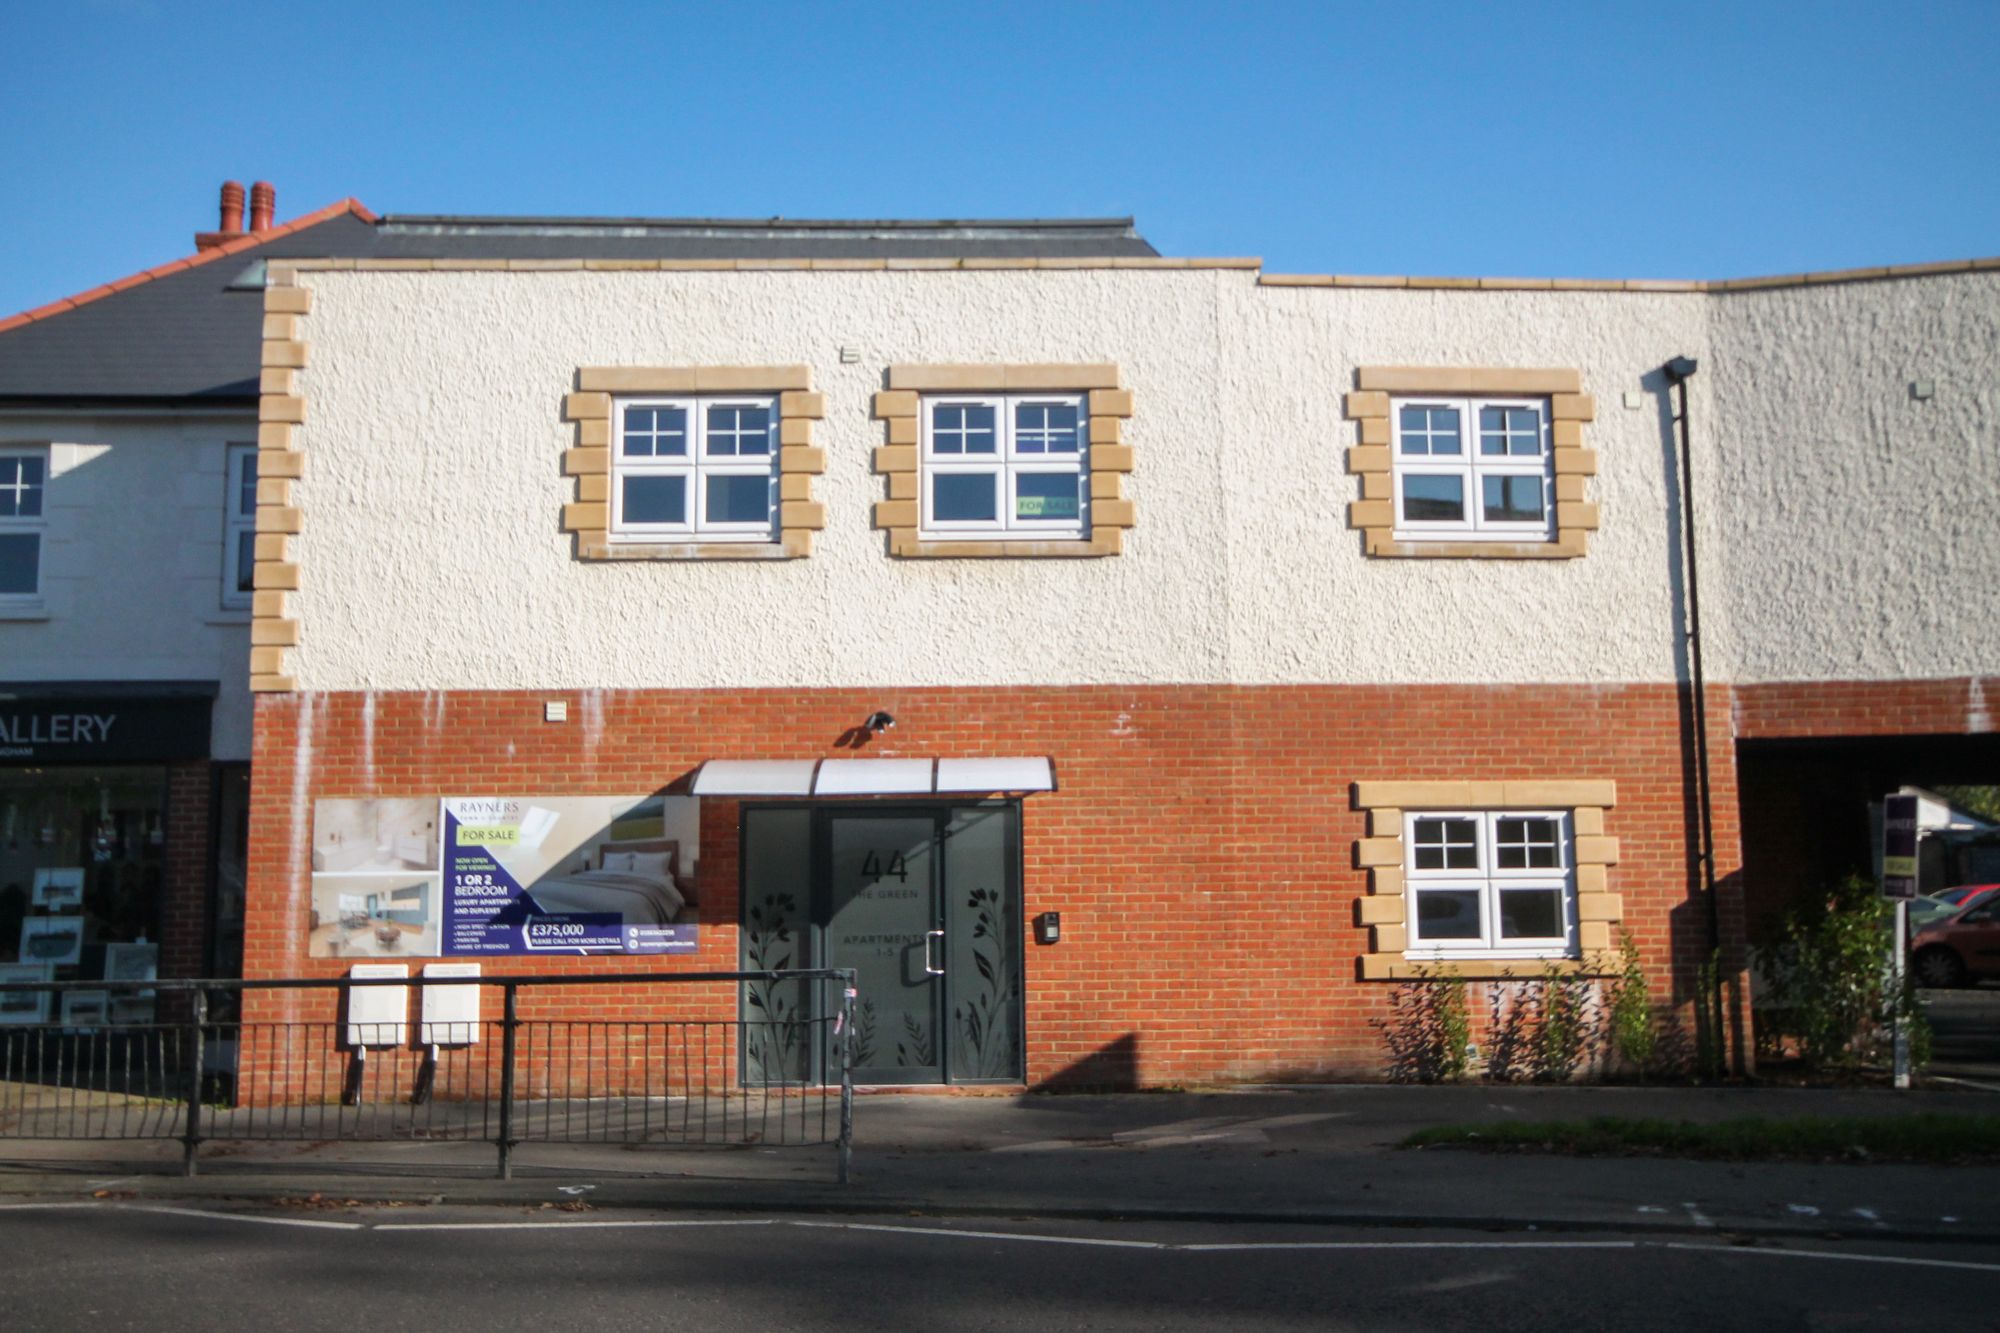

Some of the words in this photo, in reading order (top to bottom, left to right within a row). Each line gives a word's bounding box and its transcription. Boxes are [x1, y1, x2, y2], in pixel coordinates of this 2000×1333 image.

[1020, 501, 1042, 510] FOR
[460, 801, 519, 812] RAYNERS
[463, 830, 485, 840] FOR
[488, 830, 515, 840] SALE
[861, 849, 908, 883] 44
[455, 875, 462, 886] 1
[464, 874, 483, 886] OR
[484, 874, 492, 886] 2
[454, 885, 508, 896] BEDROOM
[878, 889, 918, 899] GREEN
[532, 924, 584, 937] £375,000
[844, 934, 926, 944] APARTMENTS
